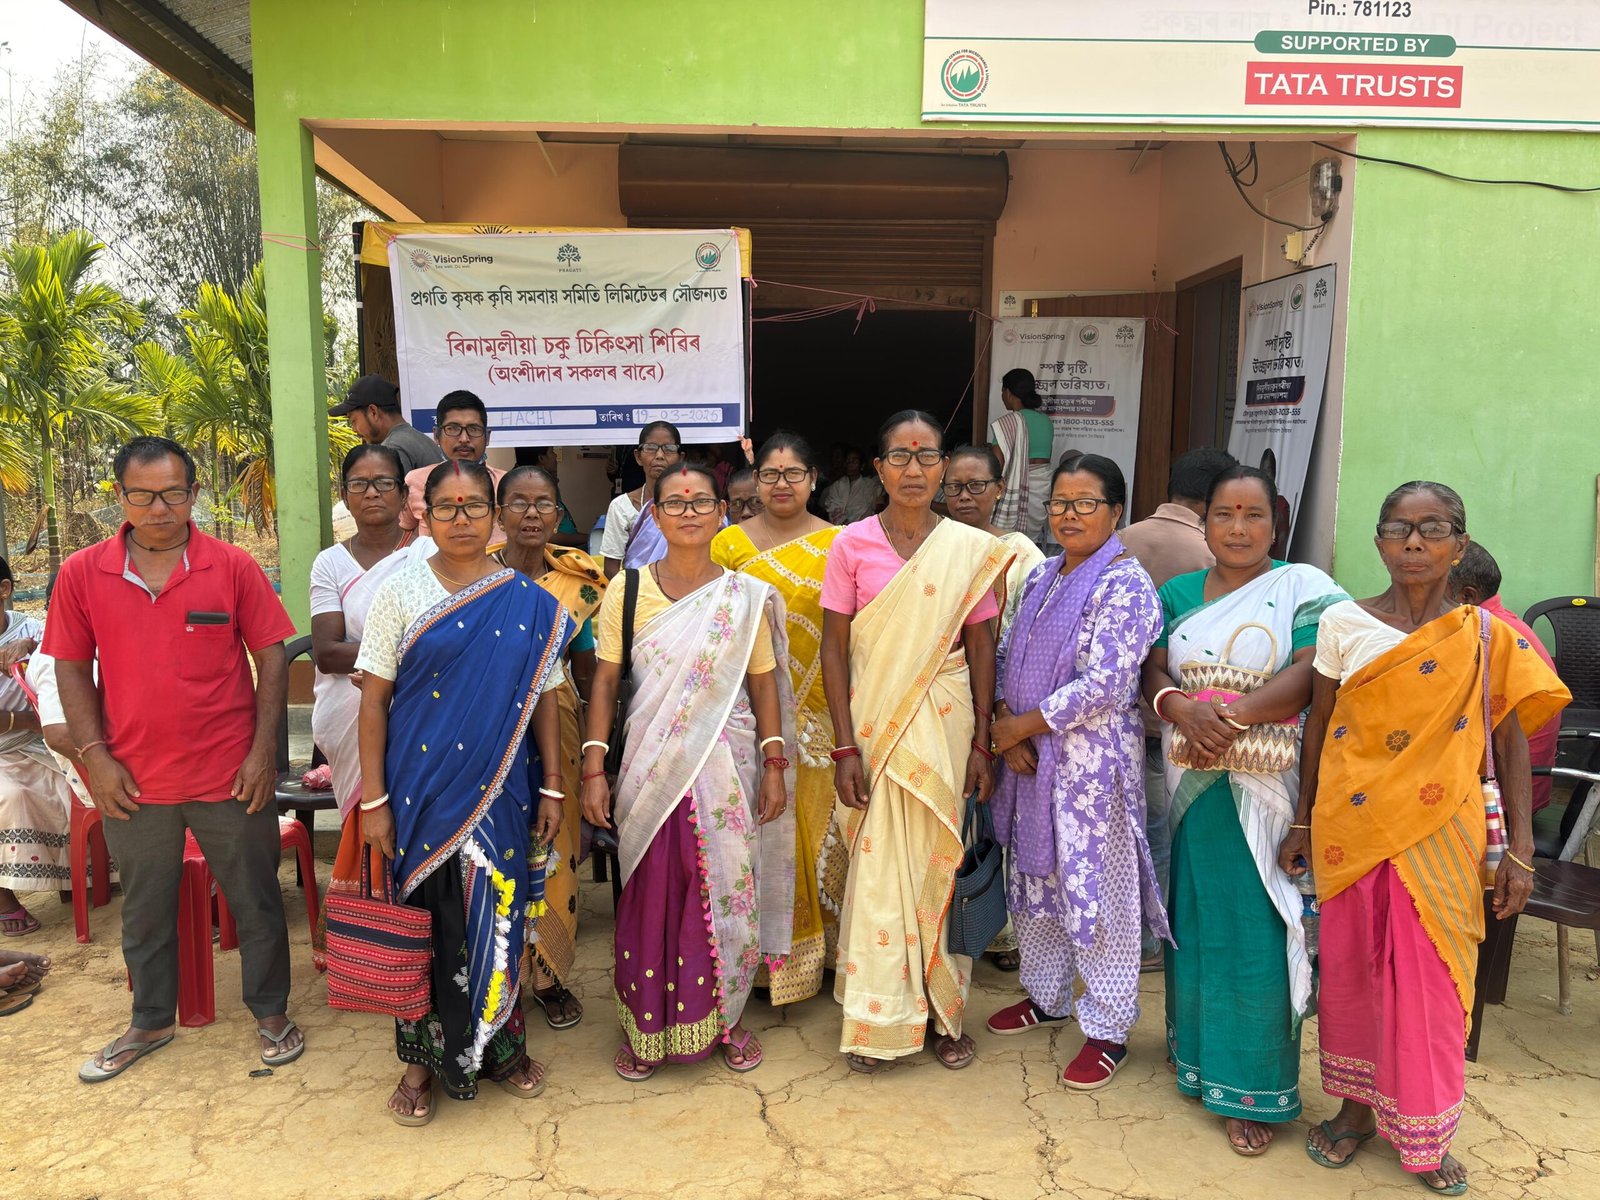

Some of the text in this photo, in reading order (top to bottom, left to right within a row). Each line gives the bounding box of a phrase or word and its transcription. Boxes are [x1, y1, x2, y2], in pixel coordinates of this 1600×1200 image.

[1352, 1, 1412, 17] 781123
[1280, 35, 1430, 52] SUPPORTED BY
[1254, 72, 1456, 98] TATA TRUSTS
[433, 254, 494, 264] VisionSpring
[451, 290, 484, 310] কৃষক
[487, 285, 513, 310] কৃষি
[517, 288, 558, 304] সমবায়
[562, 283, 601, 304] সমিতি
[604, 282, 667, 304] লিমিটেডৰ
[673, 283, 728, 302] সৌজন্যত
[446, 328, 701, 361] বিনামূলীয়া চকু চিকিৎসা শিৱিৰ
[1020, 333, 1066, 341] VisionSpring
[488, 360, 665, 386] (অংশীদাৰ সকলৰ বাবে)
